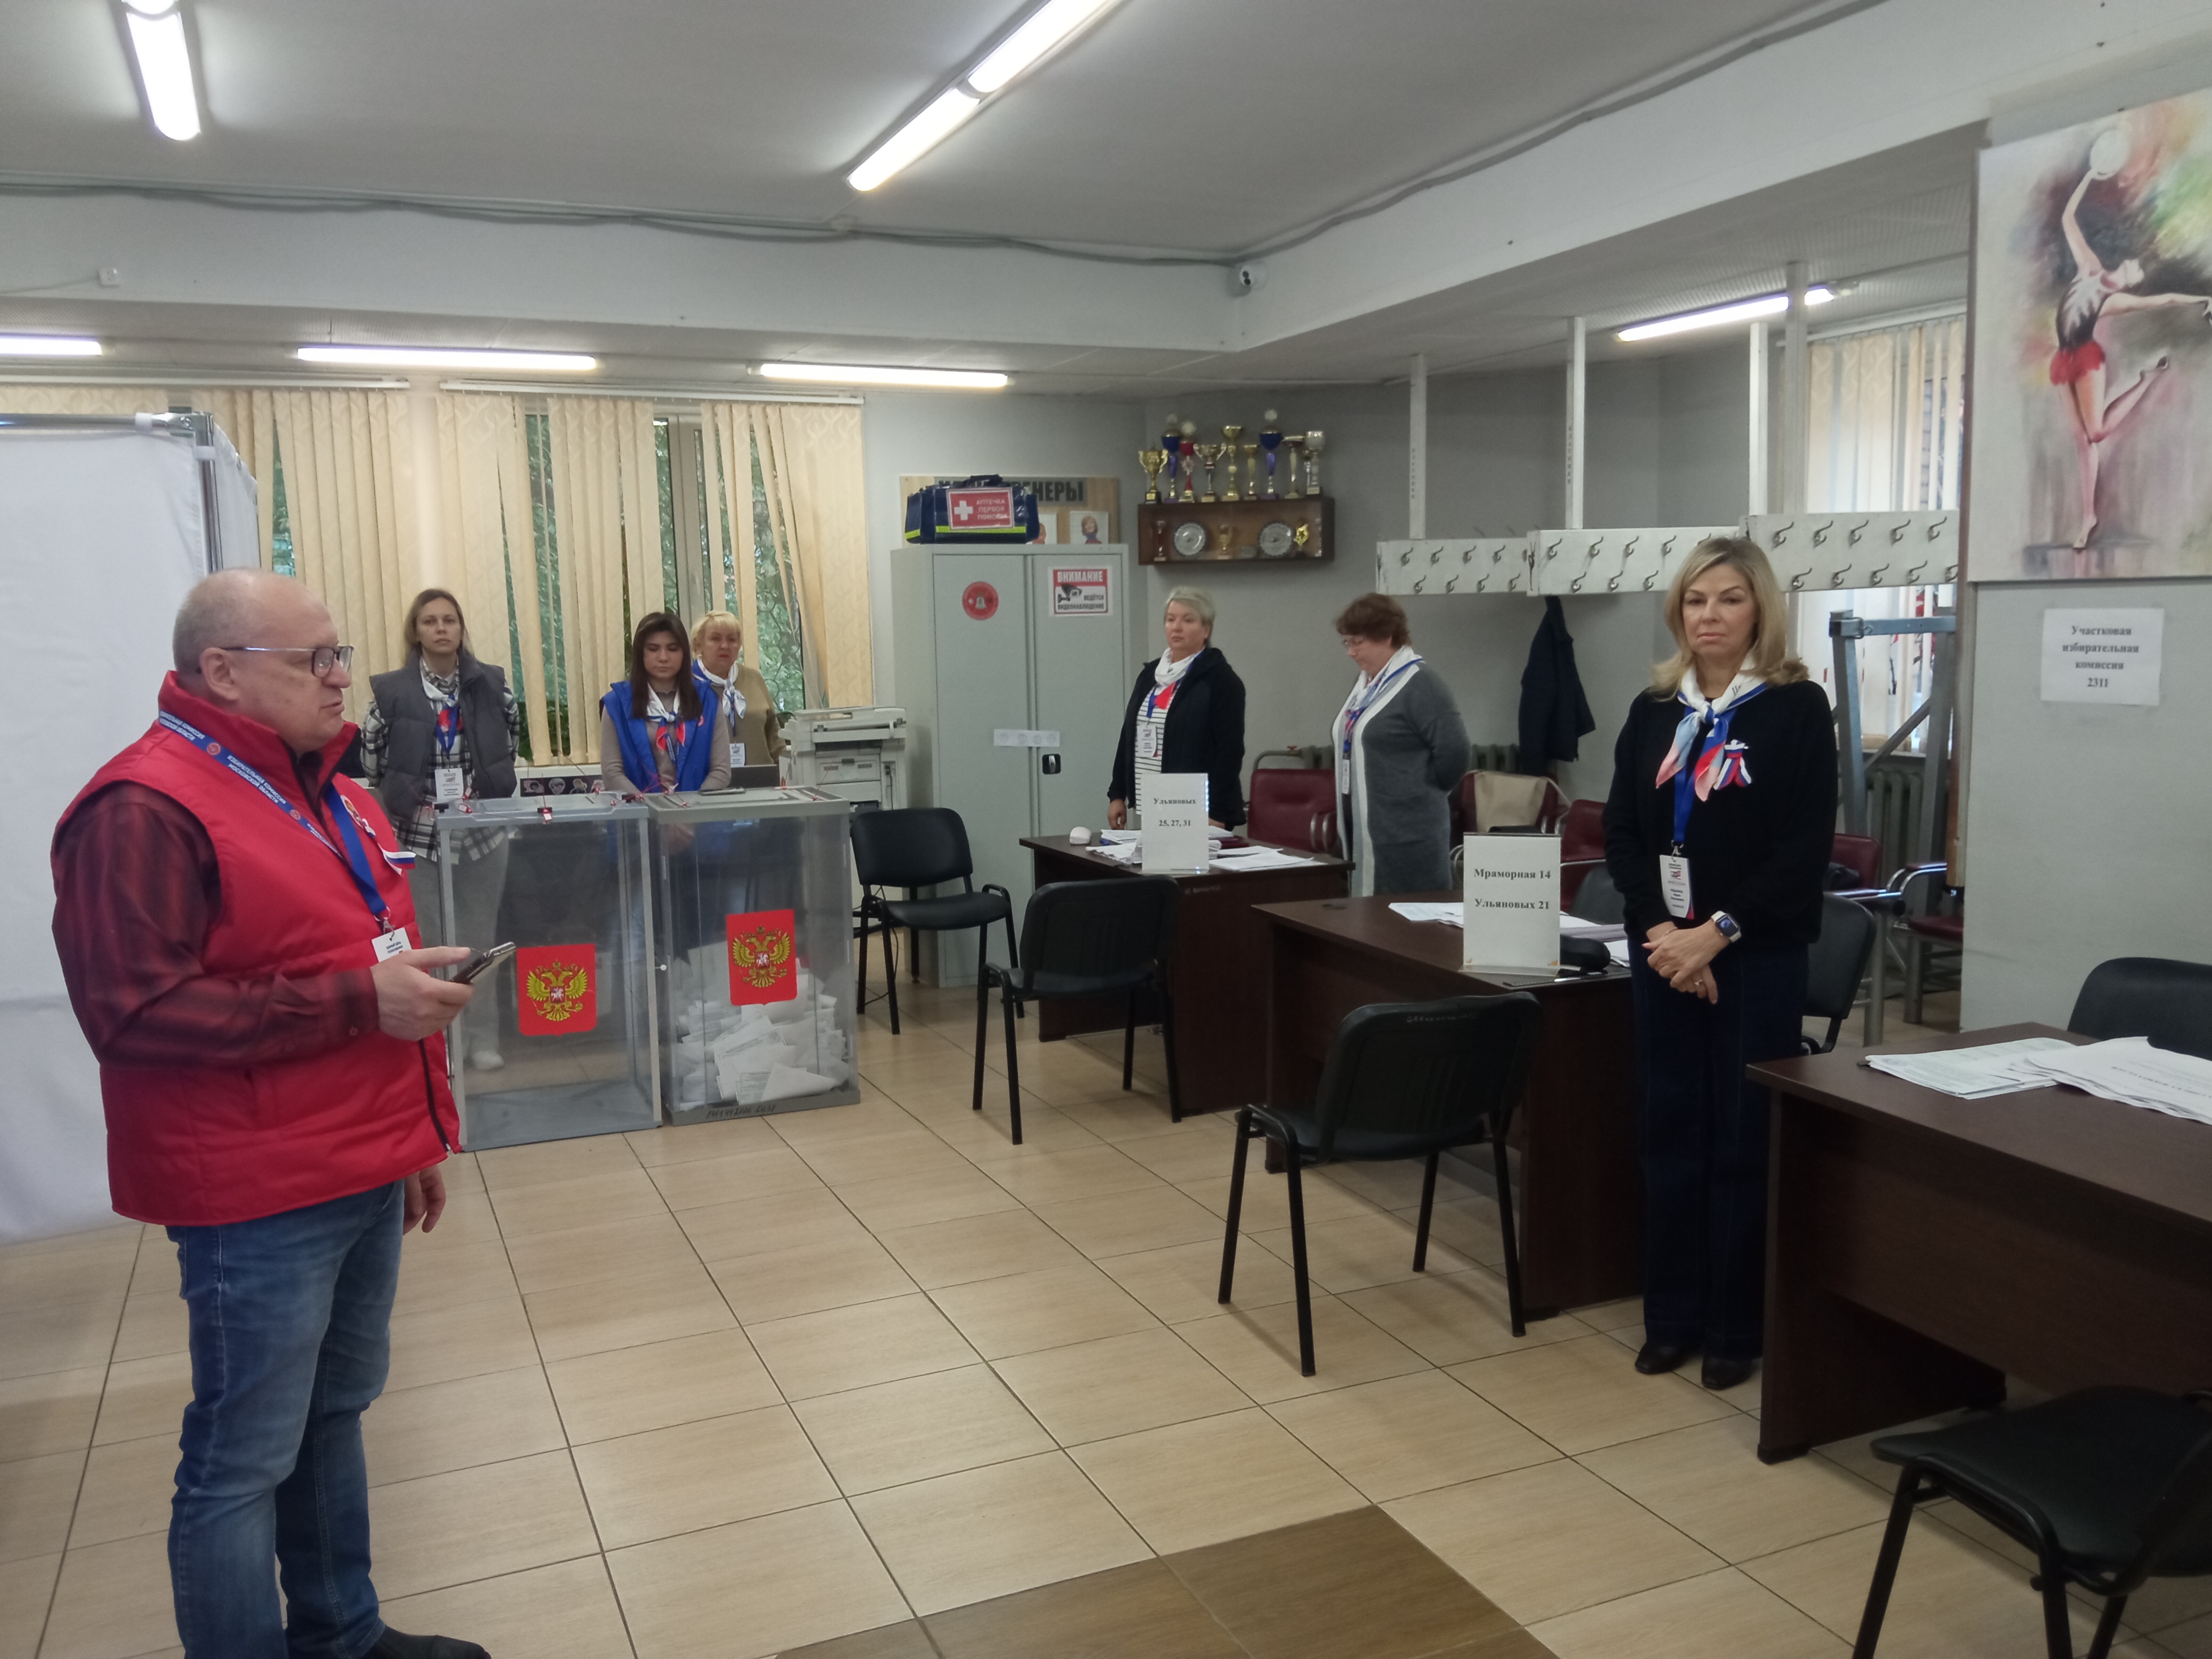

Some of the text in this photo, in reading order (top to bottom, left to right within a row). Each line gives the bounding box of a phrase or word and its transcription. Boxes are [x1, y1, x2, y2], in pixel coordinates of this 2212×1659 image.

[1058, 571, 1103, 582] ВНИМАНИЕ
[2071, 625, 2132, 636] Участковая
[2062, 643, 2140, 655] избирательная
[2075, 661, 2124, 670] комиссия
[2087, 678, 2108, 688] 2311
[228, 763, 279, 803] МОСКОВСКОЙ ОБЛАСТИ
[263, 782, 287, 805] КОМИССИЯ
[1474, 868, 1551, 880] Мраморная 14
[1474, 898, 1550, 910] Ульяновых 21
